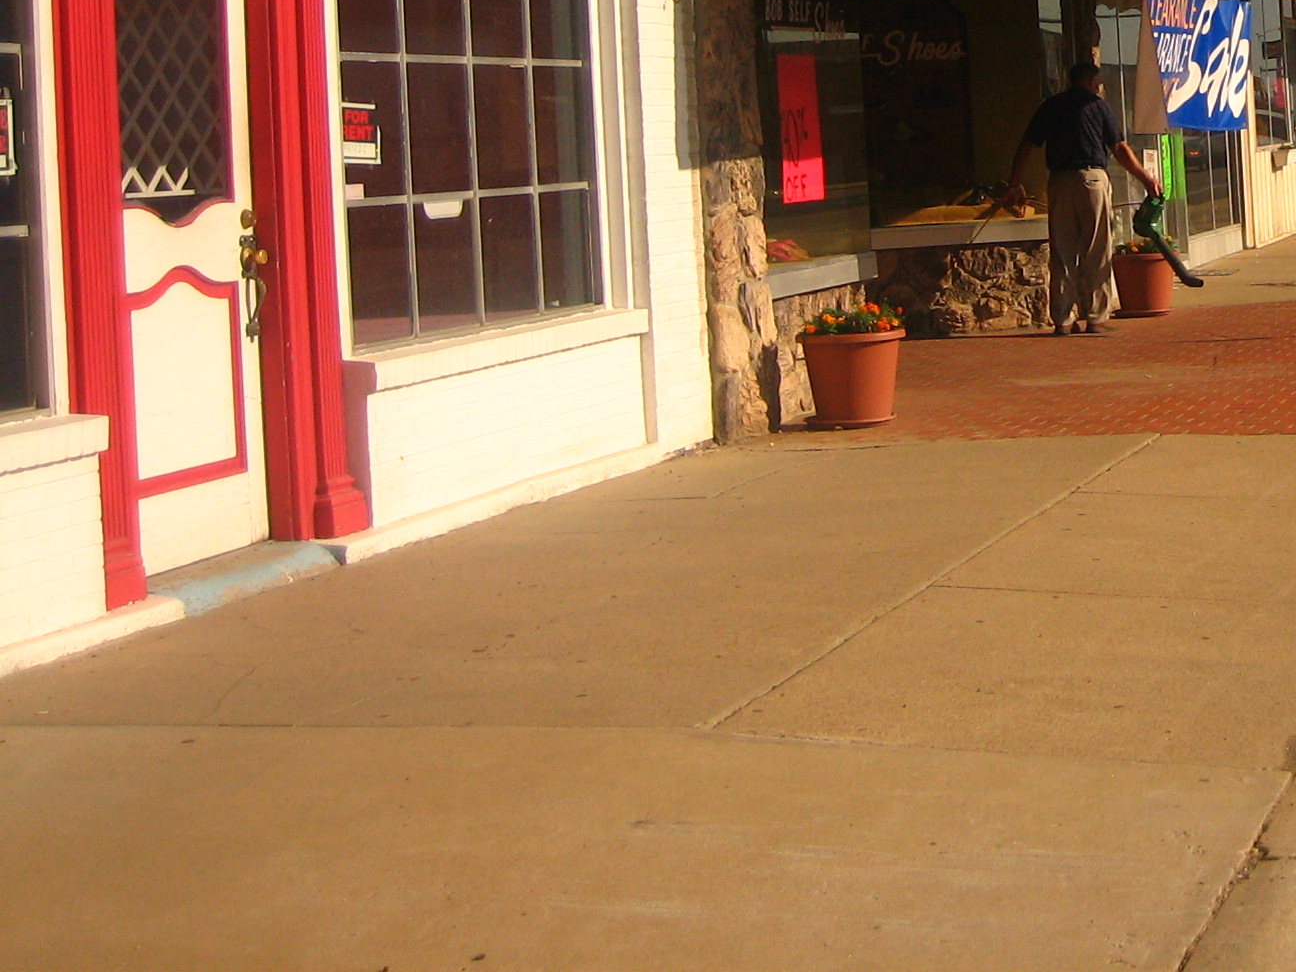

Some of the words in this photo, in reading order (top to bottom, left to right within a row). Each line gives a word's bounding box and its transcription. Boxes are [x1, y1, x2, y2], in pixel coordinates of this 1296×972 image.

[788, 0, 812, 23] SELF
[876, 30, 966, 66] Shoes
[344, 110, 371, 124] FOR
[785, 173, 808, 202] OFF
